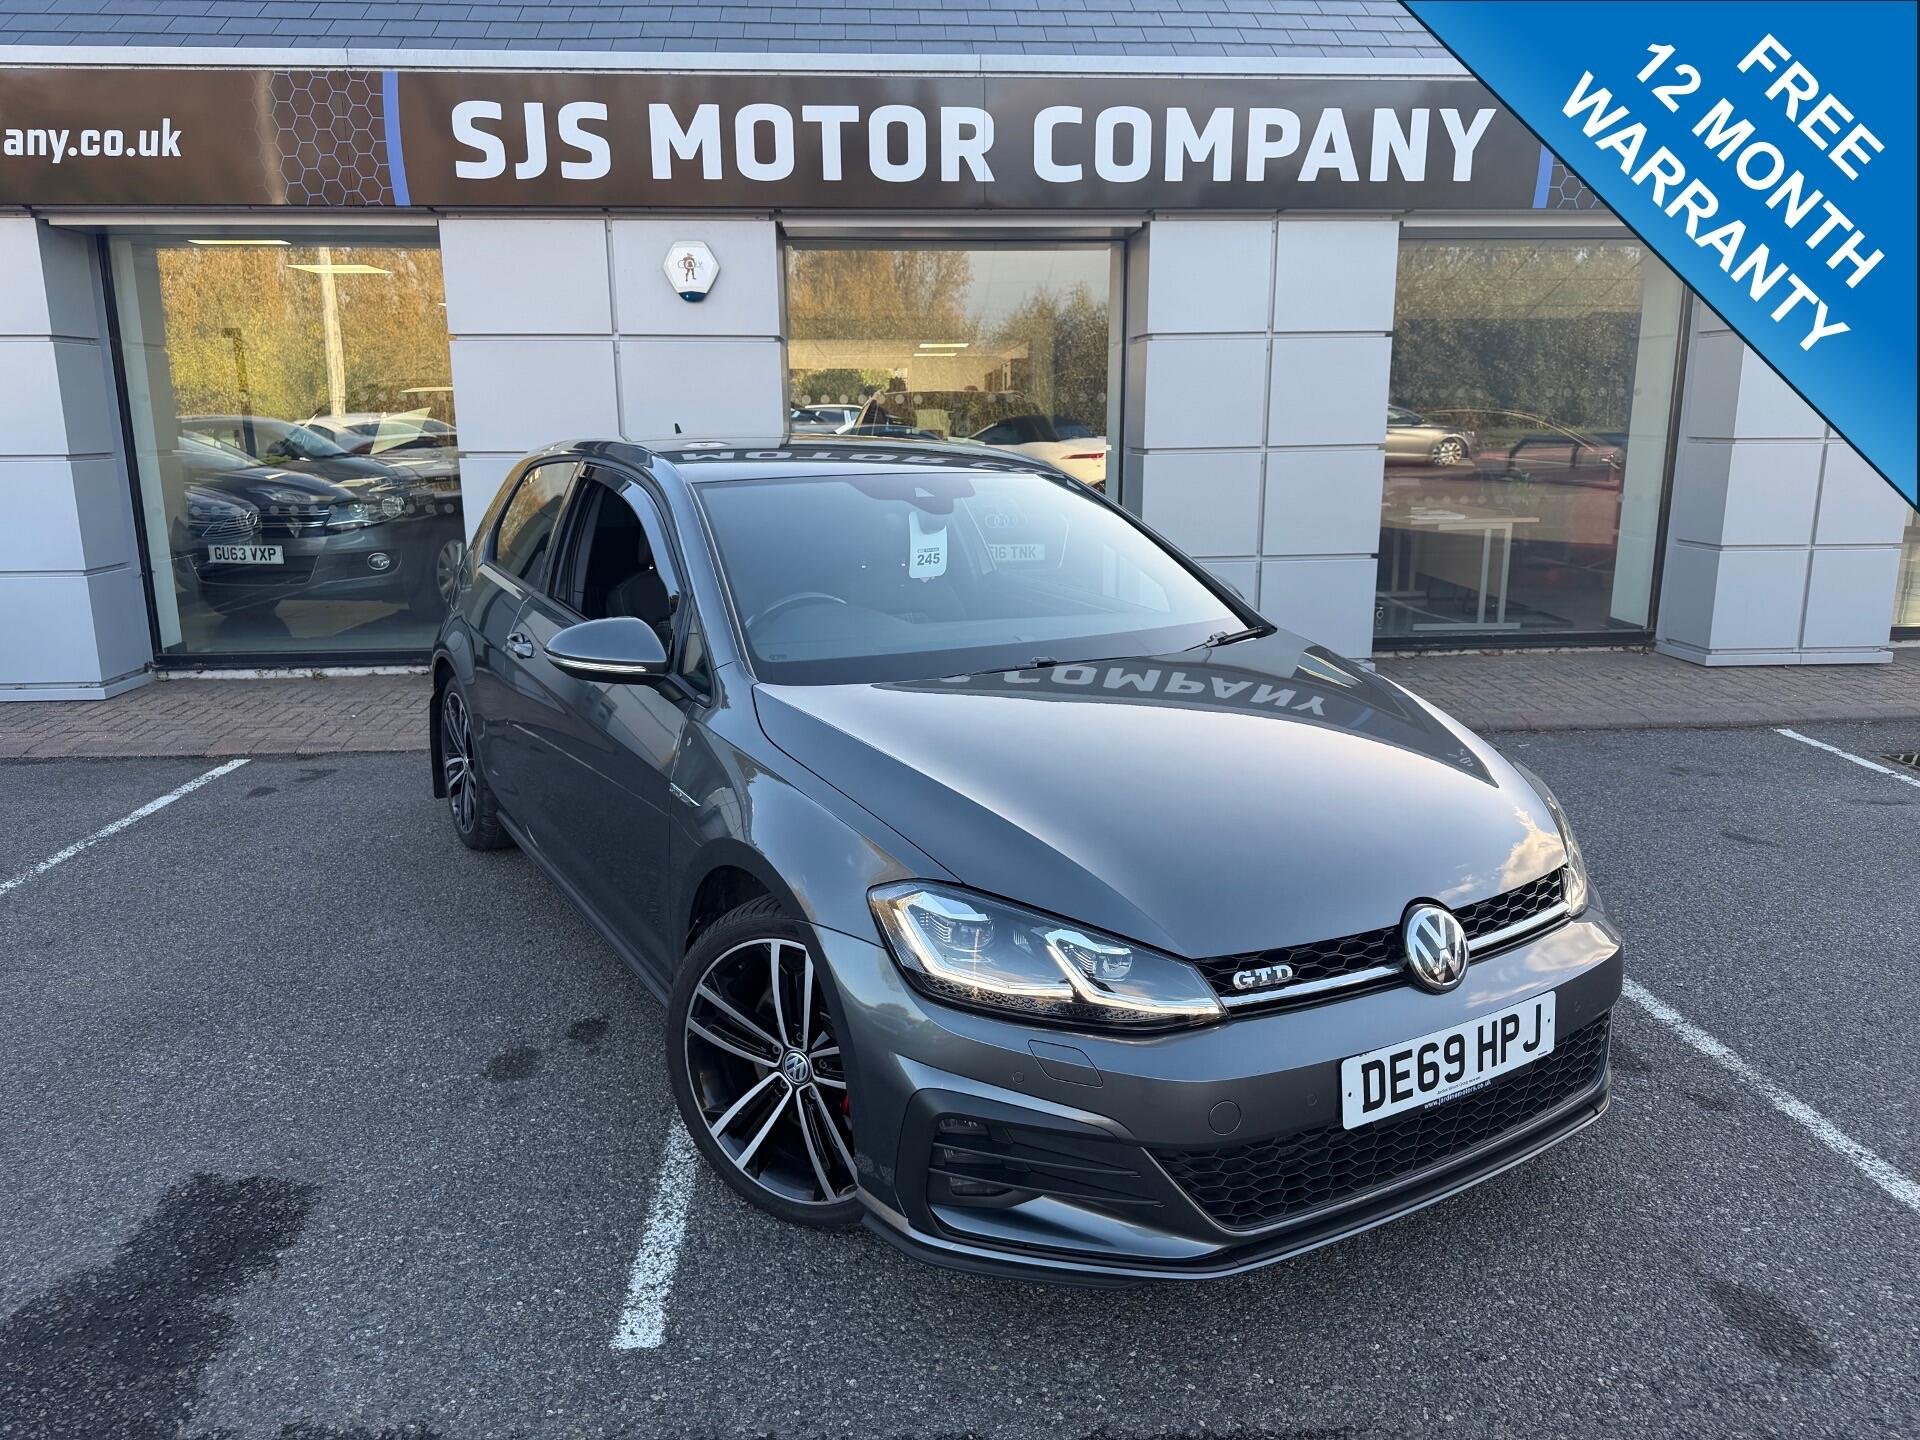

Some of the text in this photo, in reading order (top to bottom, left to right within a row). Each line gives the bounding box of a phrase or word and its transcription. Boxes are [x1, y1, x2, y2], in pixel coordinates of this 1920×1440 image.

[3, 117, 183, 165] any.co.uk
[451, 100, 1497, 183] SJS MOTOR COMPANY
[214, 546, 277, 561] GU63 VXP
[917, 552, 941, 566] 245
[1010, 546, 1037, 559] TNK
[1232, 964, 1293, 990] GTD
[1361, 1003, 1542, 1114] DE69 HPJ
